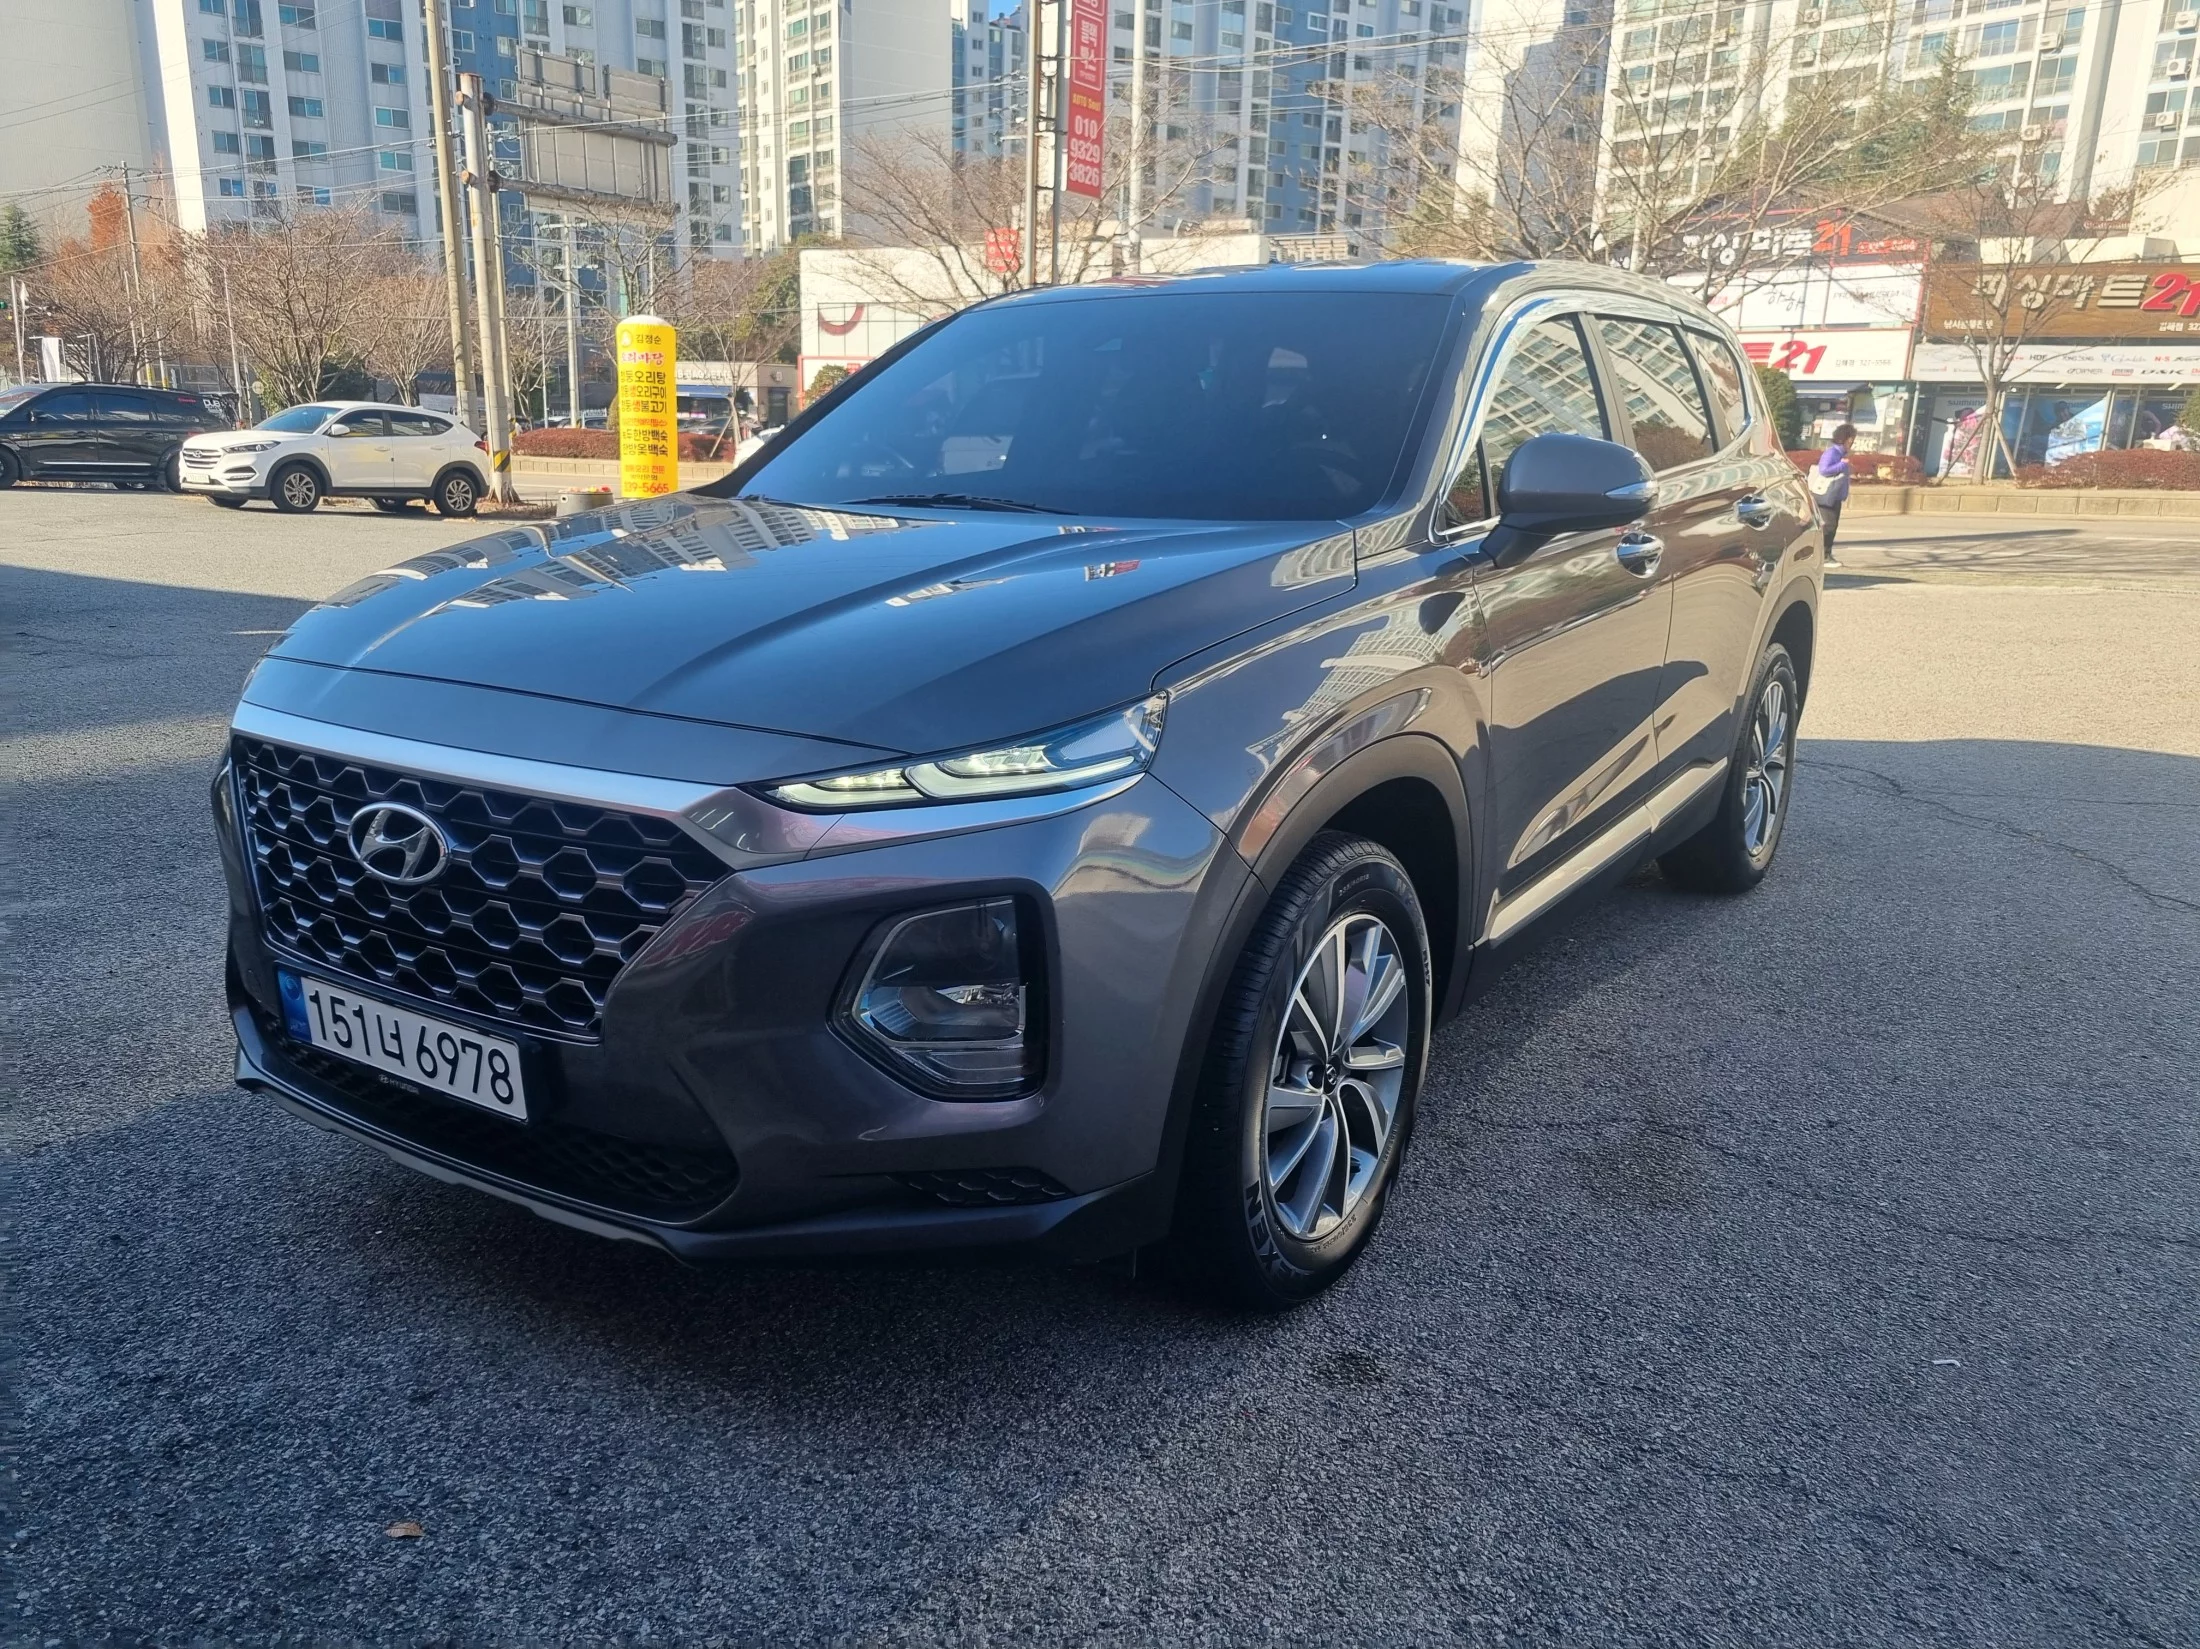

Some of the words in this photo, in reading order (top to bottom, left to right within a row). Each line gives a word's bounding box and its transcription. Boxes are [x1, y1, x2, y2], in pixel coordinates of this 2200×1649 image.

[1075, 115, 1098, 140] 010
[1070, 138, 1100, 164] 9329
[1069, 163, 1100, 188] 3826
